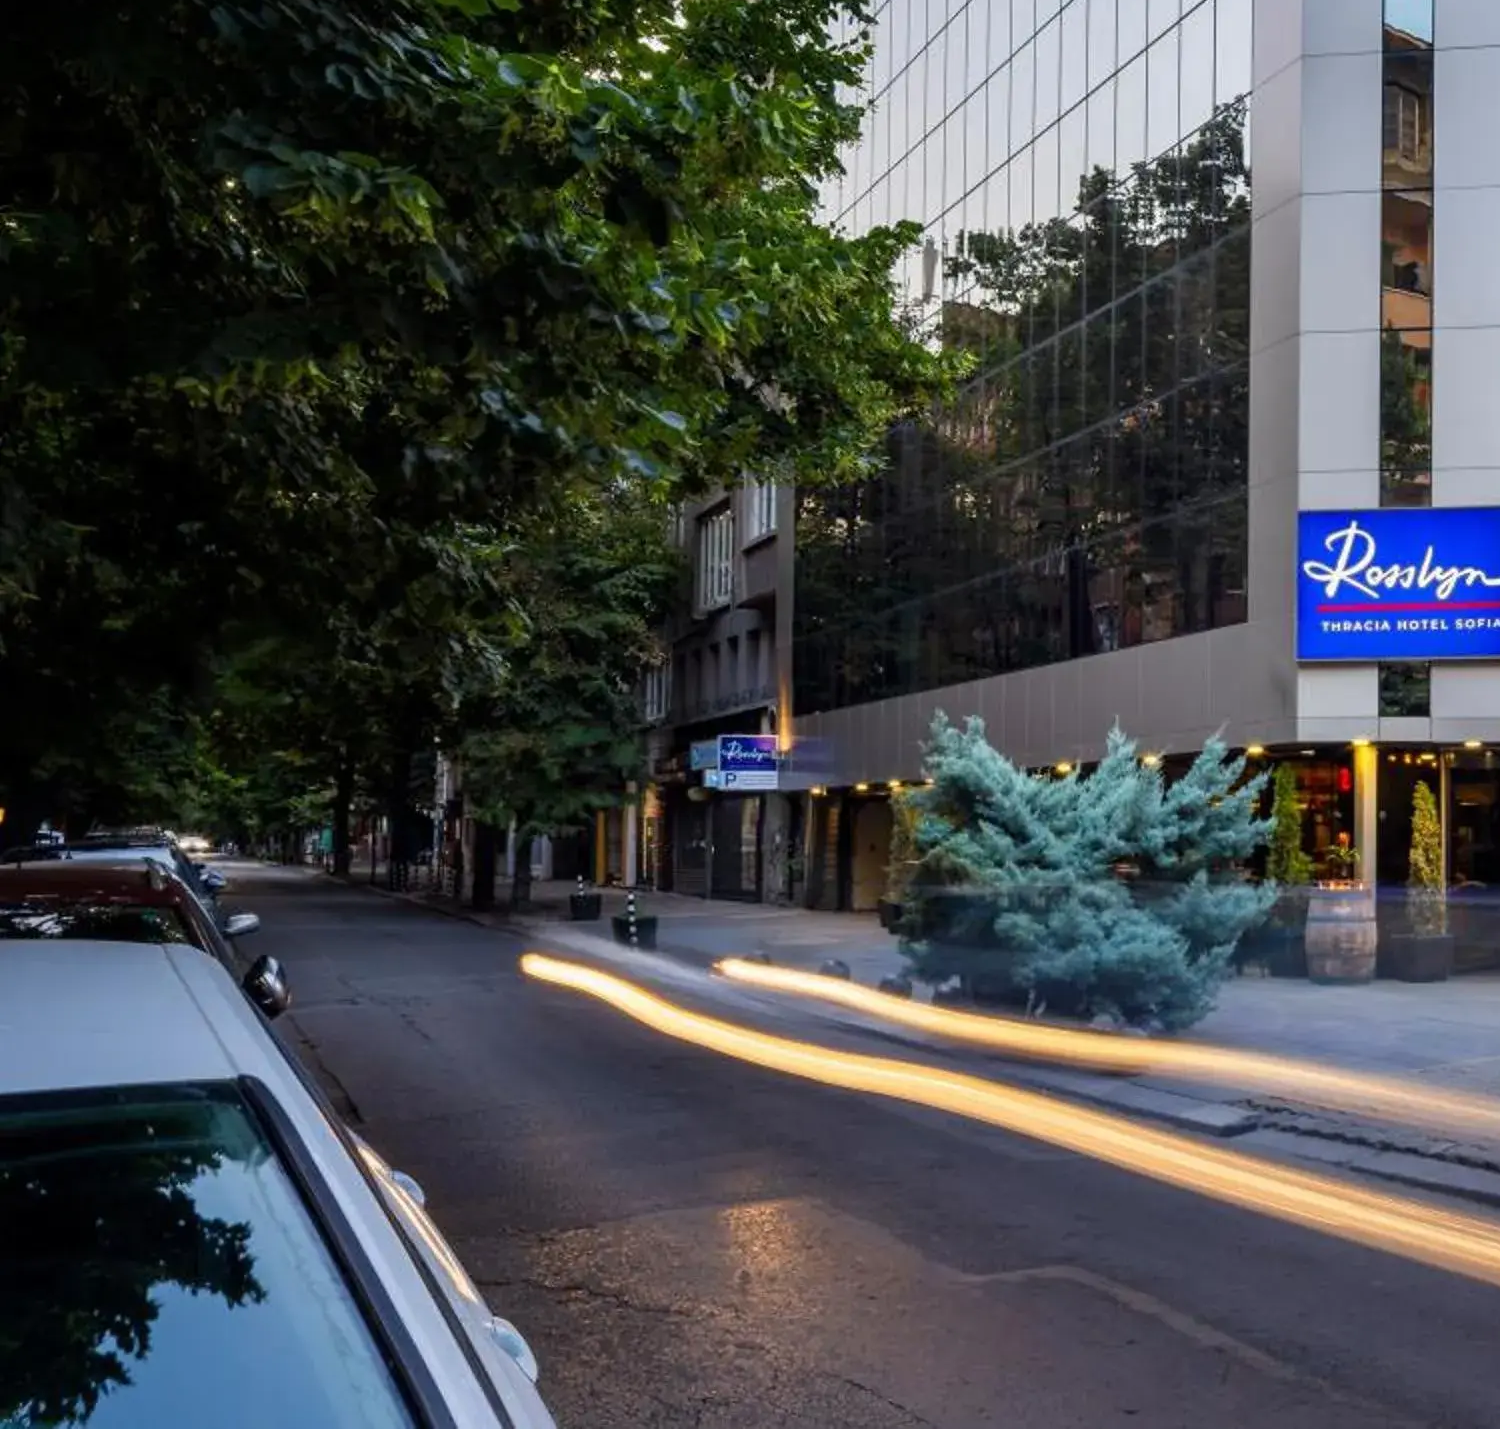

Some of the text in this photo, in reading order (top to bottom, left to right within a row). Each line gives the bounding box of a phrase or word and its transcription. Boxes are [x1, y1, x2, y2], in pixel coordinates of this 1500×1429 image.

[1321, 620, 1391, 632] THRACIA
[1397, 618, 1449, 631] HOTEL
[725, 772, 737, 787] P
